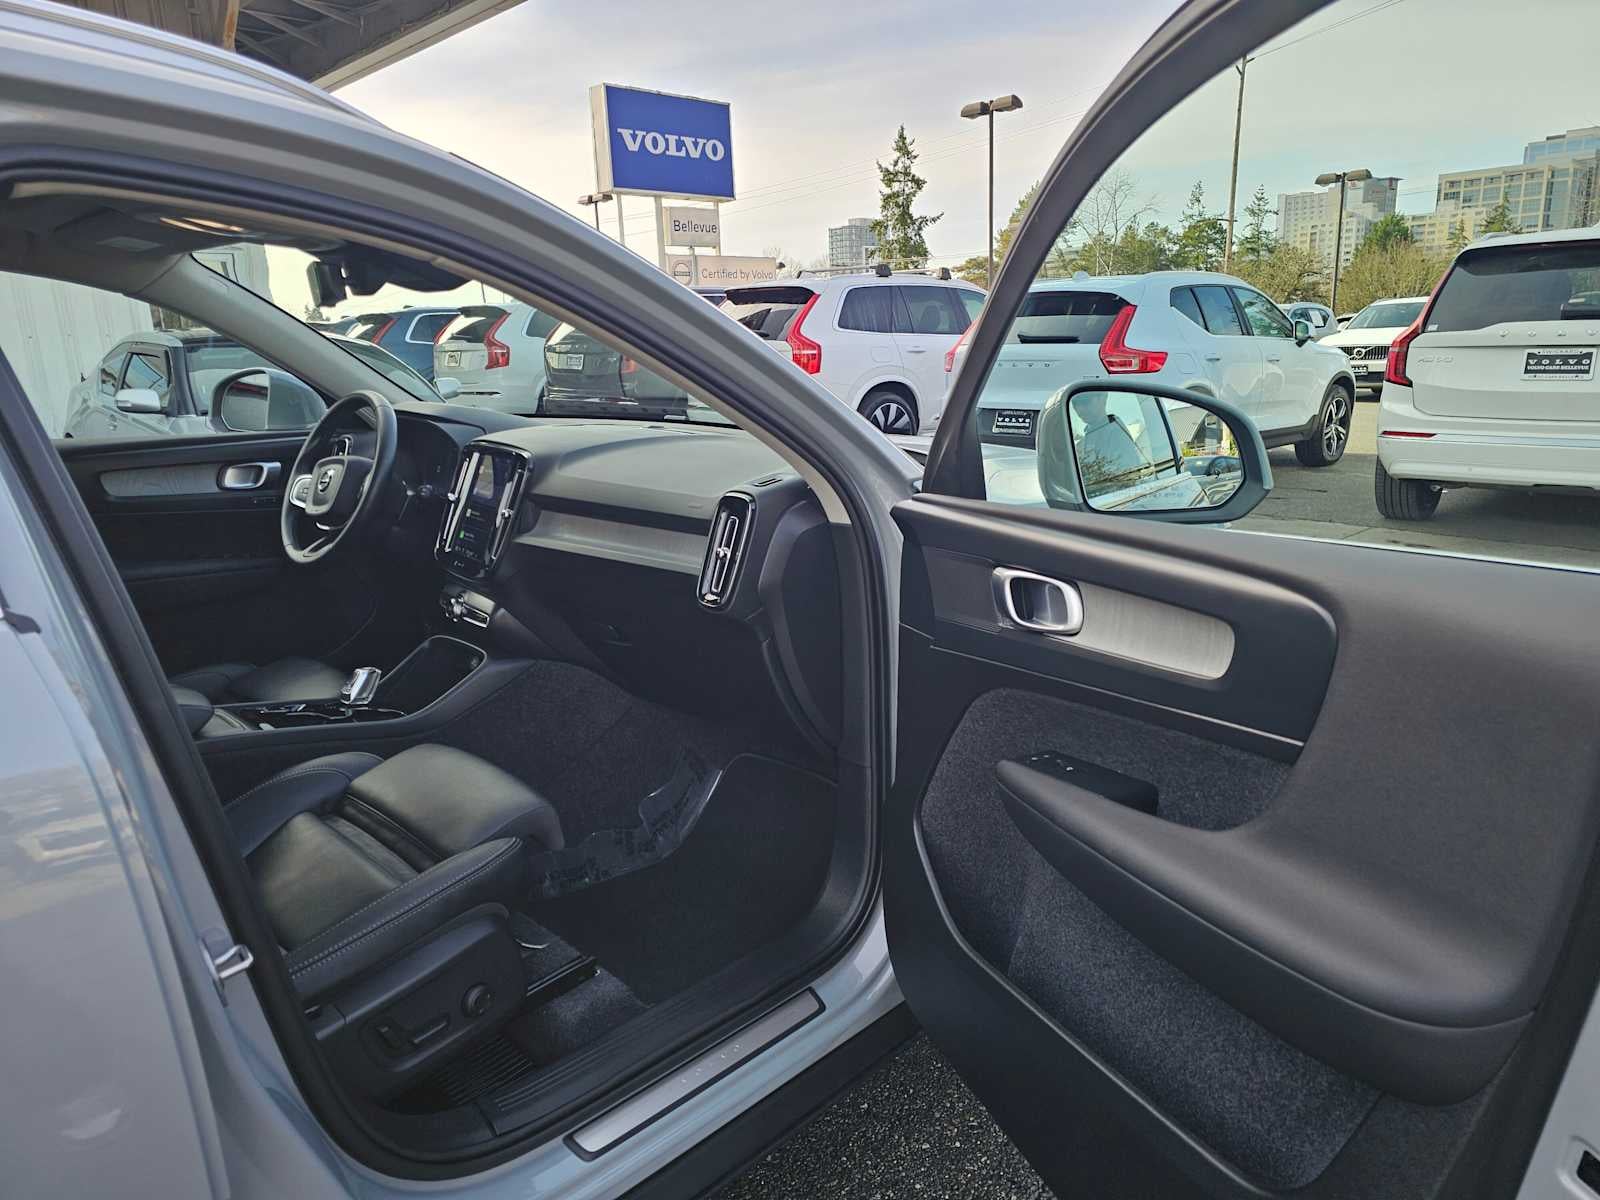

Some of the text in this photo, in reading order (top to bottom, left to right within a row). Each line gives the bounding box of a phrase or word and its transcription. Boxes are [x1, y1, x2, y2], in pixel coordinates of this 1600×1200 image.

[617, 128, 725, 161] VOLVO
[673, 220, 718, 234] Bellevue
[701, 268, 738, 280] Certified
[740, 270, 751, 281] by
[752, 270, 774, 280] Volvo
